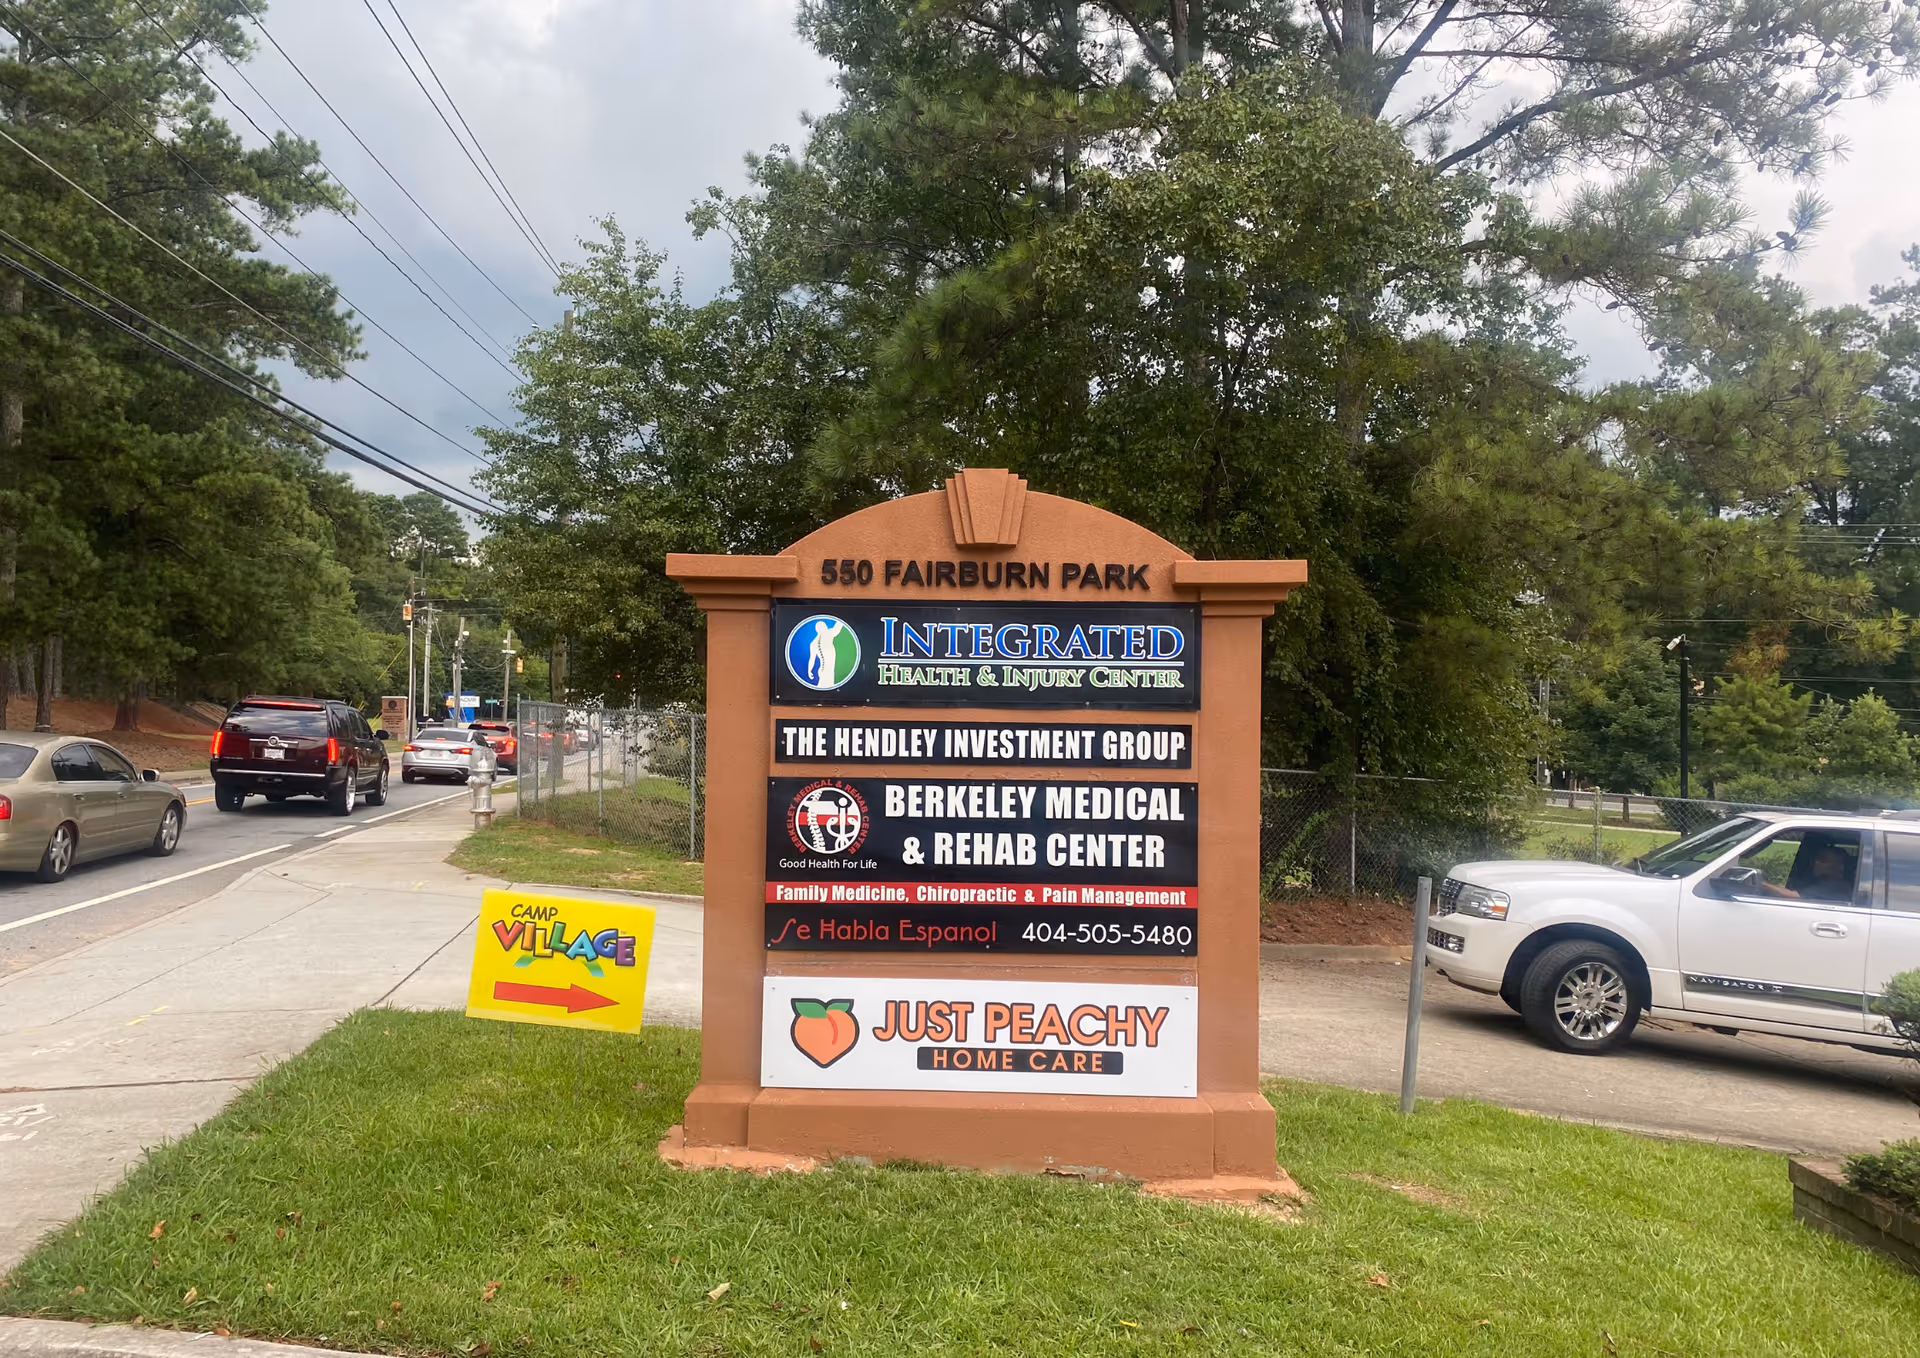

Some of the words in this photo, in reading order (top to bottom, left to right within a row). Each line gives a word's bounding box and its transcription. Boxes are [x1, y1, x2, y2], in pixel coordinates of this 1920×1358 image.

[821, 559, 873, 585] 550
[885, 560, 1050, 588] FAIRBURN
[1062, 563, 1151, 590] PARK
[880, 616, 1185, 660] INTEGRATED
[878, 664, 971, 687] HEALTH
[976, 668, 996, 687] &
[1002, 666, 1085, 691] INJURY
[1089, 666, 1185, 689] CENTER
[783, 727, 826, 756] THE
[834, 727, 936, 758] HENDLEY
[944, 728, 1096, 760] INVESTMENT
[1102, 730, 1185, 761] GROUP
[793, 779, 833, 803] MEDICAL
[835, 780, 843, 788] &
[844, 784, 868, 813] REHAB
[885, 785, 1037, 820] BERKELEY
[1045, 786, 1185, 821] MEDICAL
[786, 804, 807, 853] BERKELEY
[848, 816, 869, 855] CENTER
[779, 858, 806, 868] Good
[809, 858, 840, 869] Health
[843, 859, 858, 869] For
[860, 859, 878, 869] Life
[902, 836, 925, 865] &
[934, 832, 1037, 867] REHAB
[1046, 833, 1165, 868] CENTER
[776, 884, 828, 903] Family
[832, 884, 909, 903] Medicine,
[916, 886, 1017, 906] Chiropractic
[1024, 889, 1036, 902] &
[1043, 888, 1077, 904] Pain
[1081, 889, 1187, 910] Management
[511, 903, 558, 922] CAMP
[492, 919, 636, 967] VILLAGE
[771, 918, 811, 944] Se
[820, 919, 889, 941] Habla
[900, 920, 997, 948] Espanol
[1021, 922, 1192, 945] 404-505-5480
[872, 1000, 974, 1042] JUST
[984, 1002, 1170, 1048] PEACHY
[933, 1049, 1014, 1070] HOME
[1029, 1052, 1104, 1072] CARE
